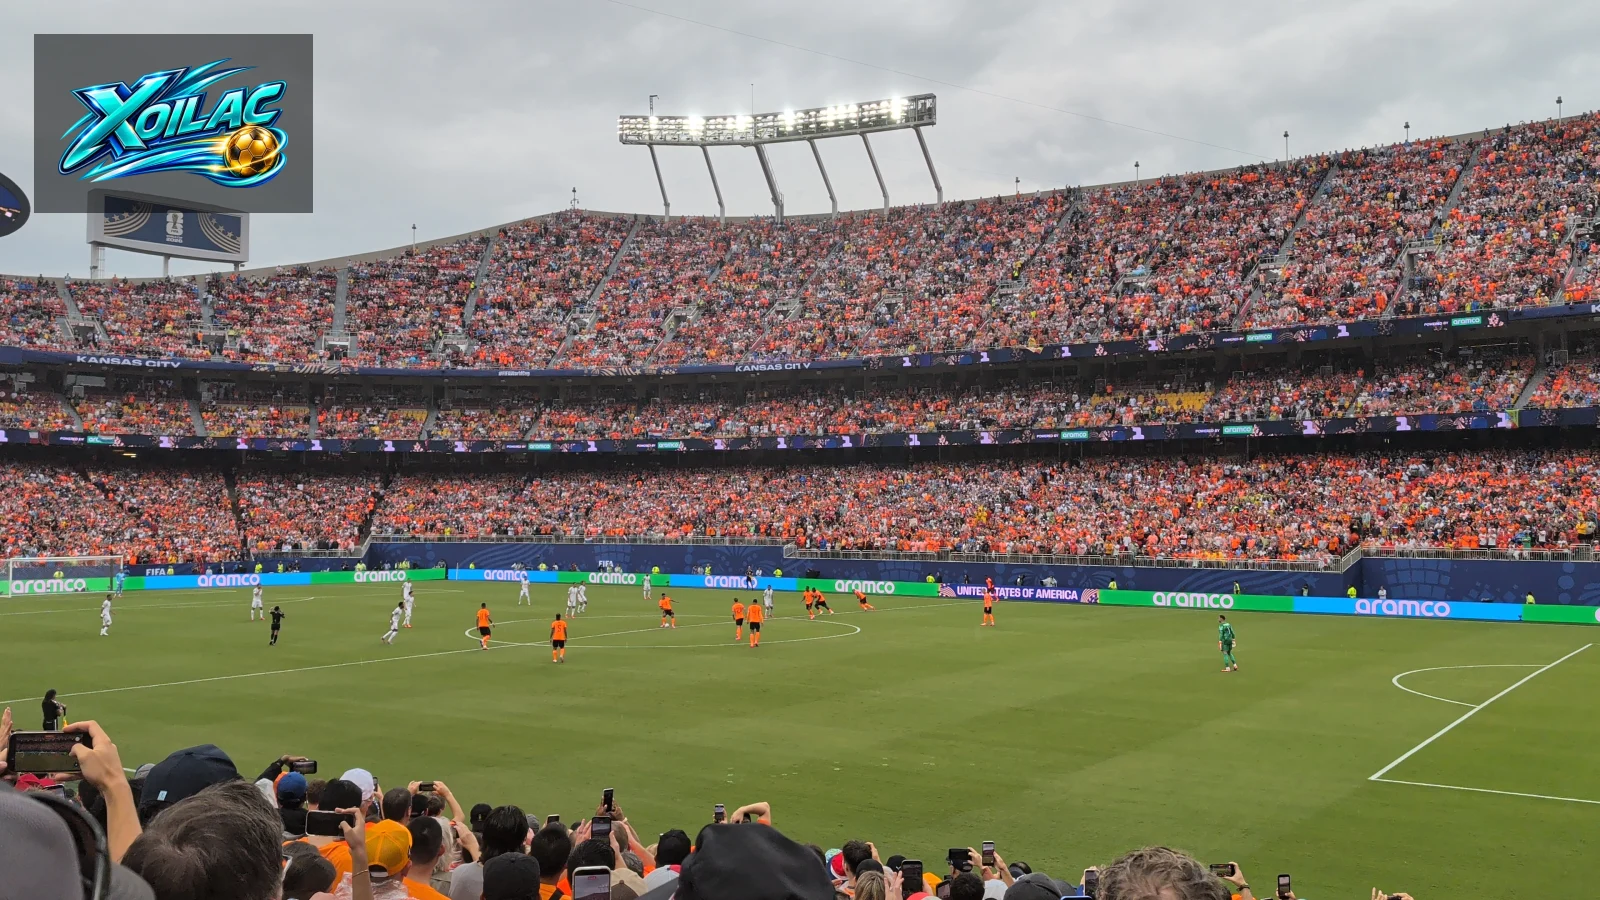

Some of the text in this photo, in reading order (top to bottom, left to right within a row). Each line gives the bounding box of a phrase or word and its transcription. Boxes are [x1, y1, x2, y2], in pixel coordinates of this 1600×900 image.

[76, 355, 181, 369] KANSAS CITY
[735, 362, 811, 372] KANSAS CITY
[598, 560, 613, 568] FIFA
[145, 568, 166, 576] FIFA
[354, 570, 406, 583] aramco
[484, 569, 527, 581] aramco
[588, 572, 636, 585] aramco
[11, 578, 86, 593] aramco
[197, 573, 260, 587] aramco
[704, 575, 757, 588] aramco
[835, 579, 895, 594] aramco
[1022, 588, 1034, 597] OF
[1036, 589, 1078, 600] AMERICA
[1152, 591, 1234, 609] aramco
[1355, 598, 1451, 617] aramco
